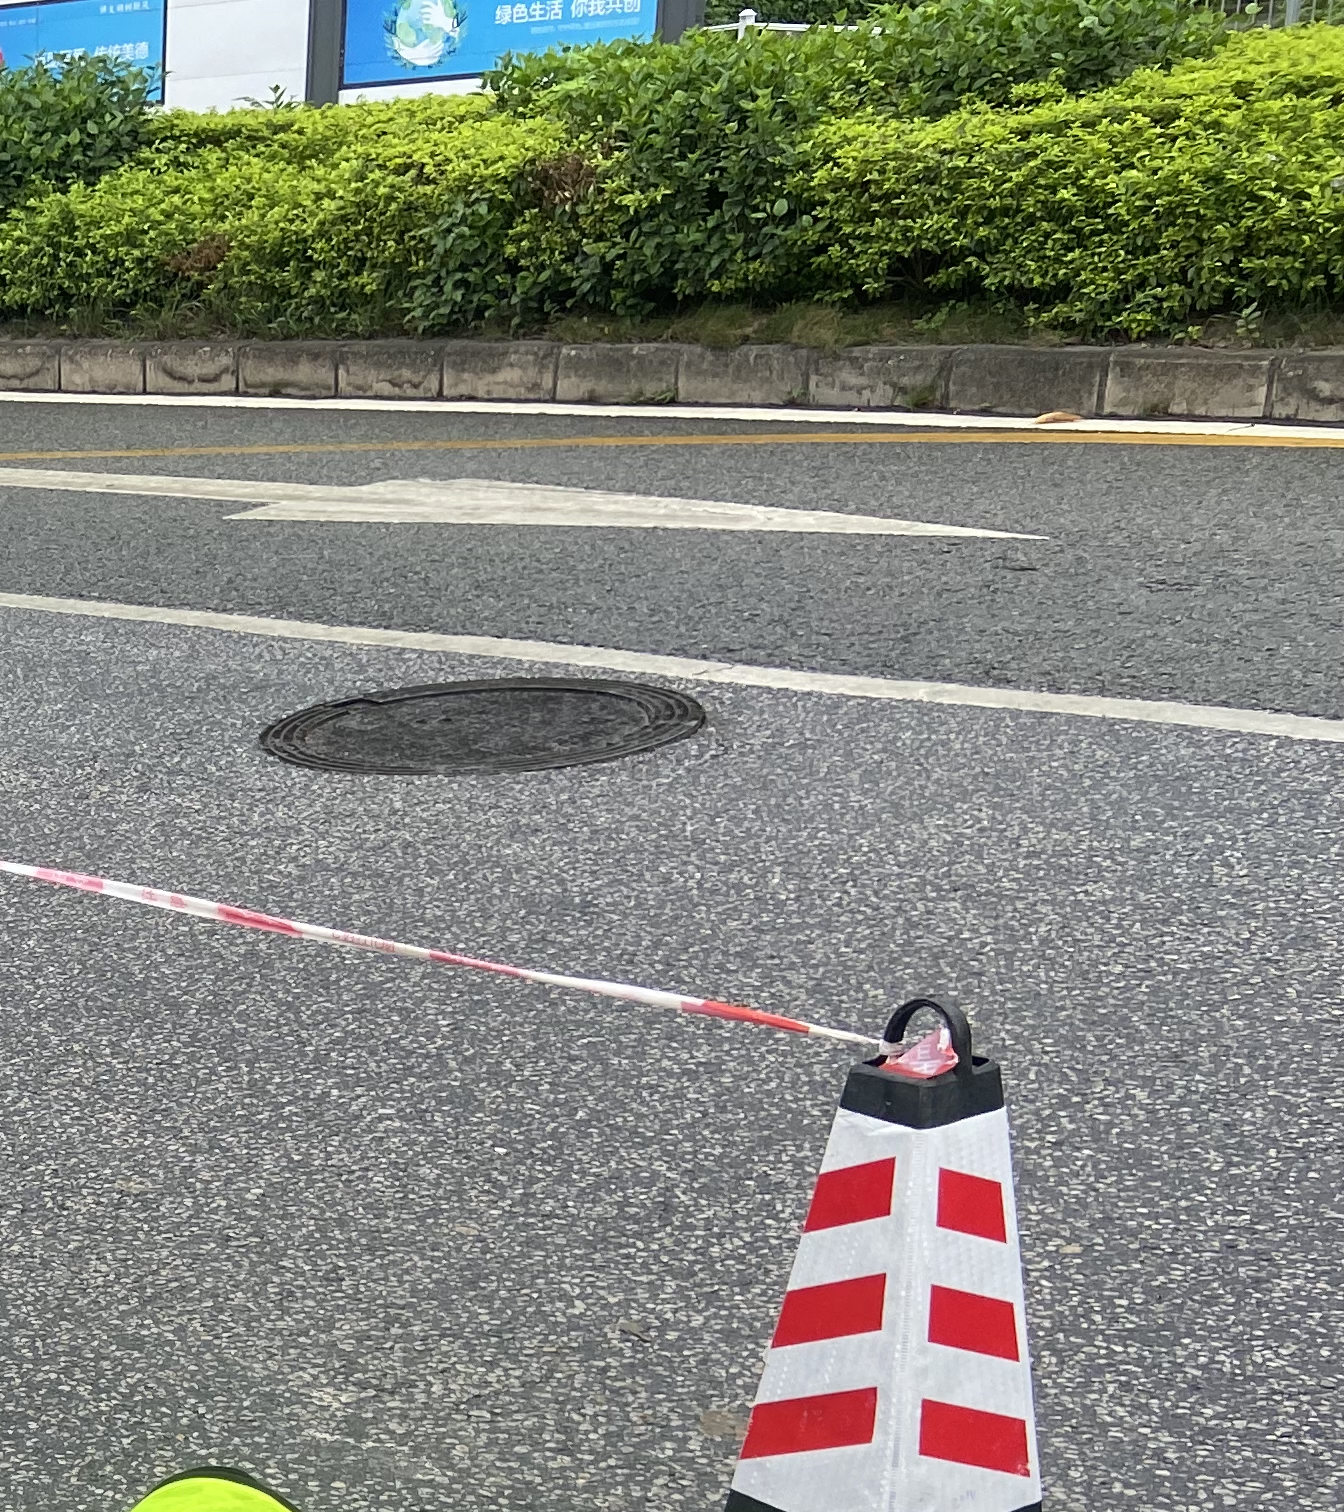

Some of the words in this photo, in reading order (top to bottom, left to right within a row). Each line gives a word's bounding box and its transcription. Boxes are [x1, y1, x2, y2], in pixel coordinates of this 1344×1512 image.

[494, 1, 564, 25] 绿色生活
[570, 0, 642, 18] 你我共创
